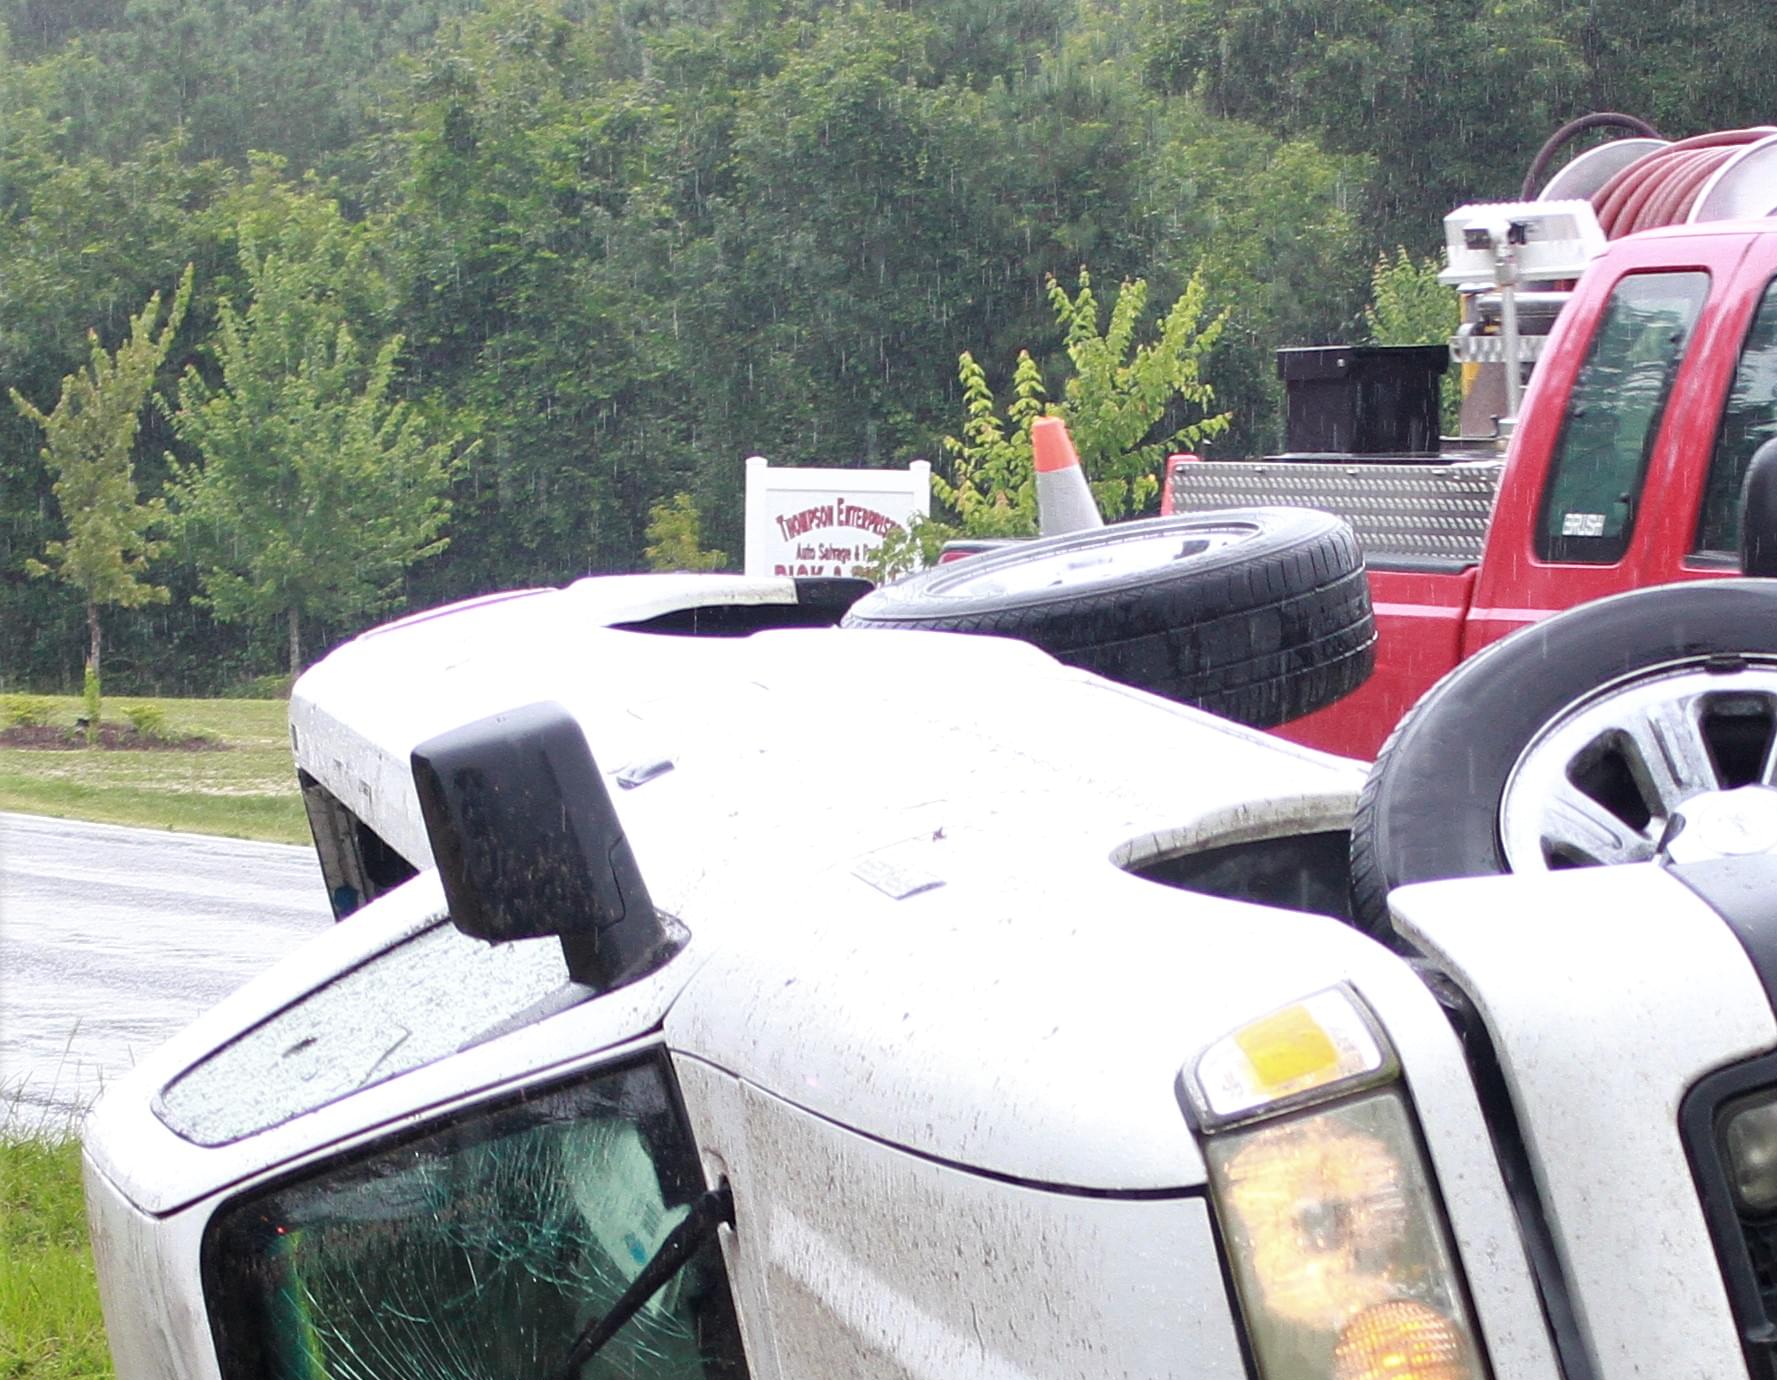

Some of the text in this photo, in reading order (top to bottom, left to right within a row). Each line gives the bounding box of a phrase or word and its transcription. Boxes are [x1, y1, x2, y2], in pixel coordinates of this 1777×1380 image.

[1562, 513, 1606, 536] BRUSH
[796, 543, 816, 560] Auto
[818, 542, 851, 565] Salvage
